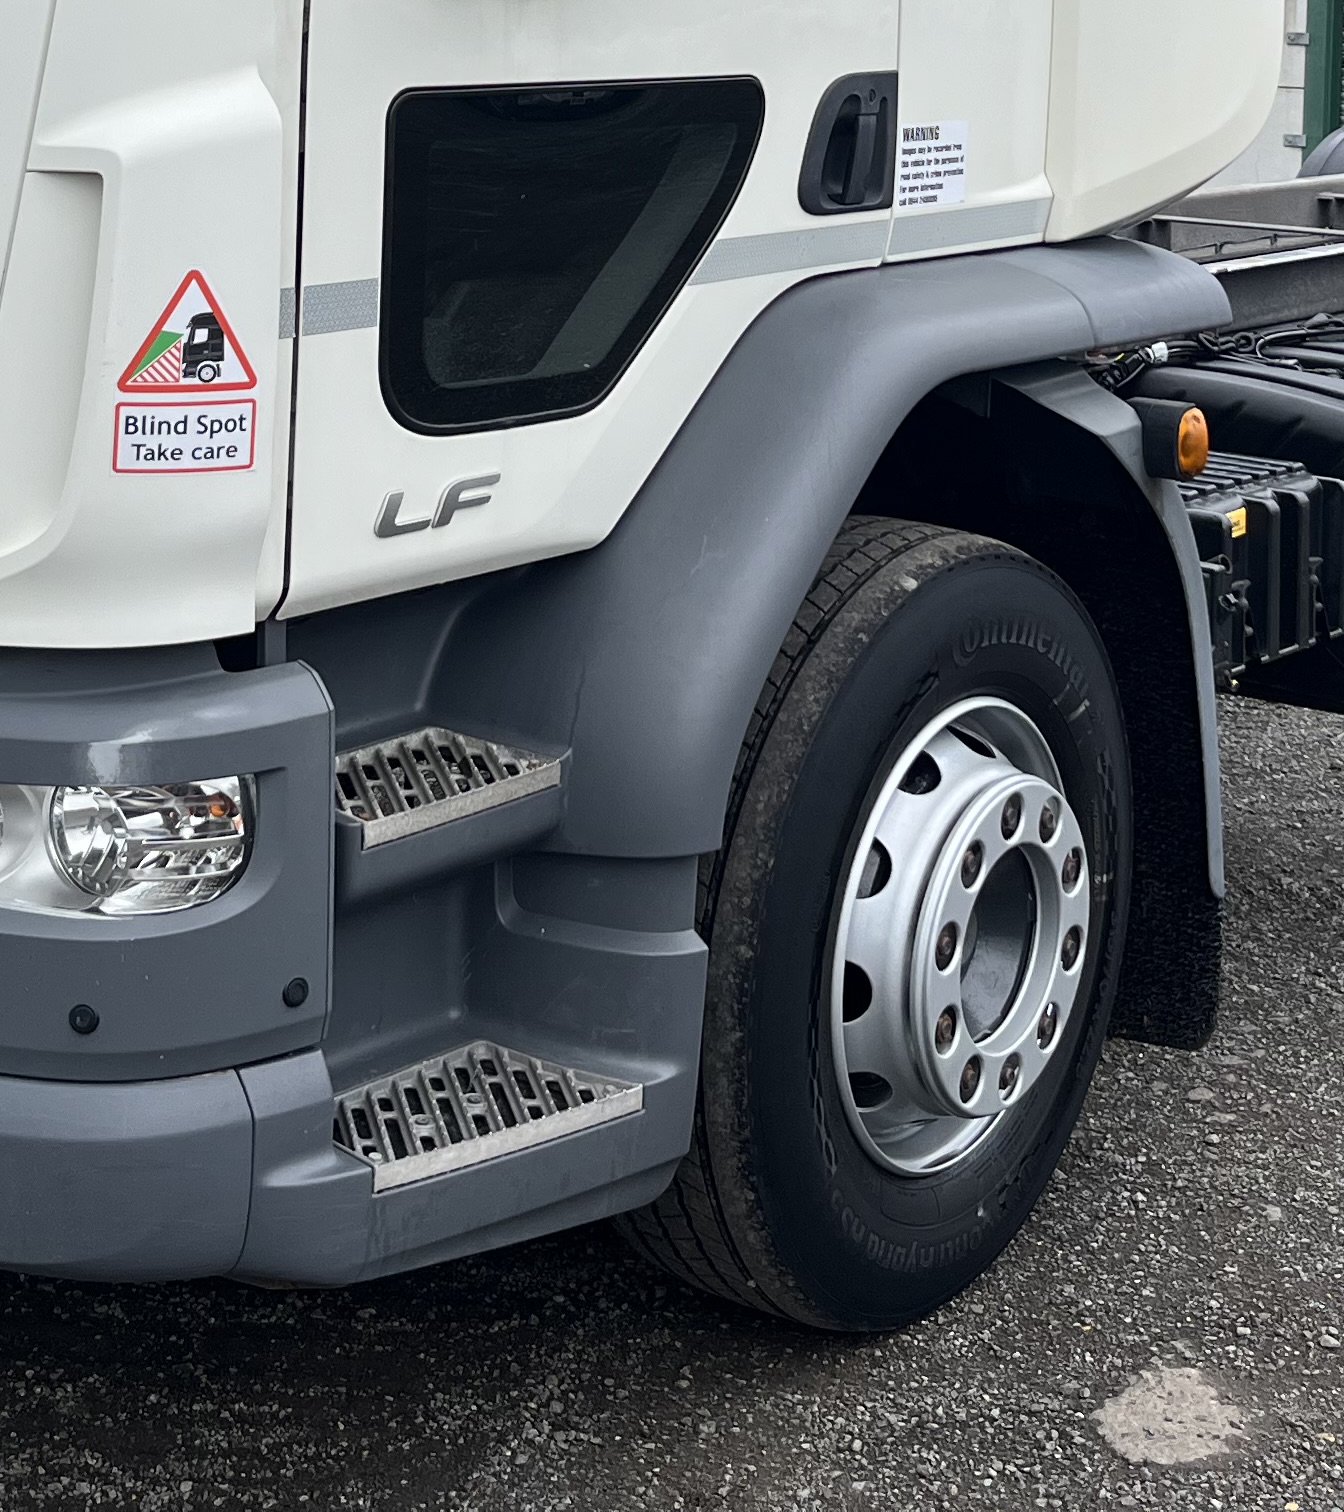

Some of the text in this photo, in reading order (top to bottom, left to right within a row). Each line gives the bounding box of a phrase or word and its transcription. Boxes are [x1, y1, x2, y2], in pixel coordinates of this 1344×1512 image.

[902, 125, 940, 143] WARNING
[124, 413, 247, 437] Blind Spot
[131, 443, 238, 462] Take care
[374, 472, 501, 538] LF
